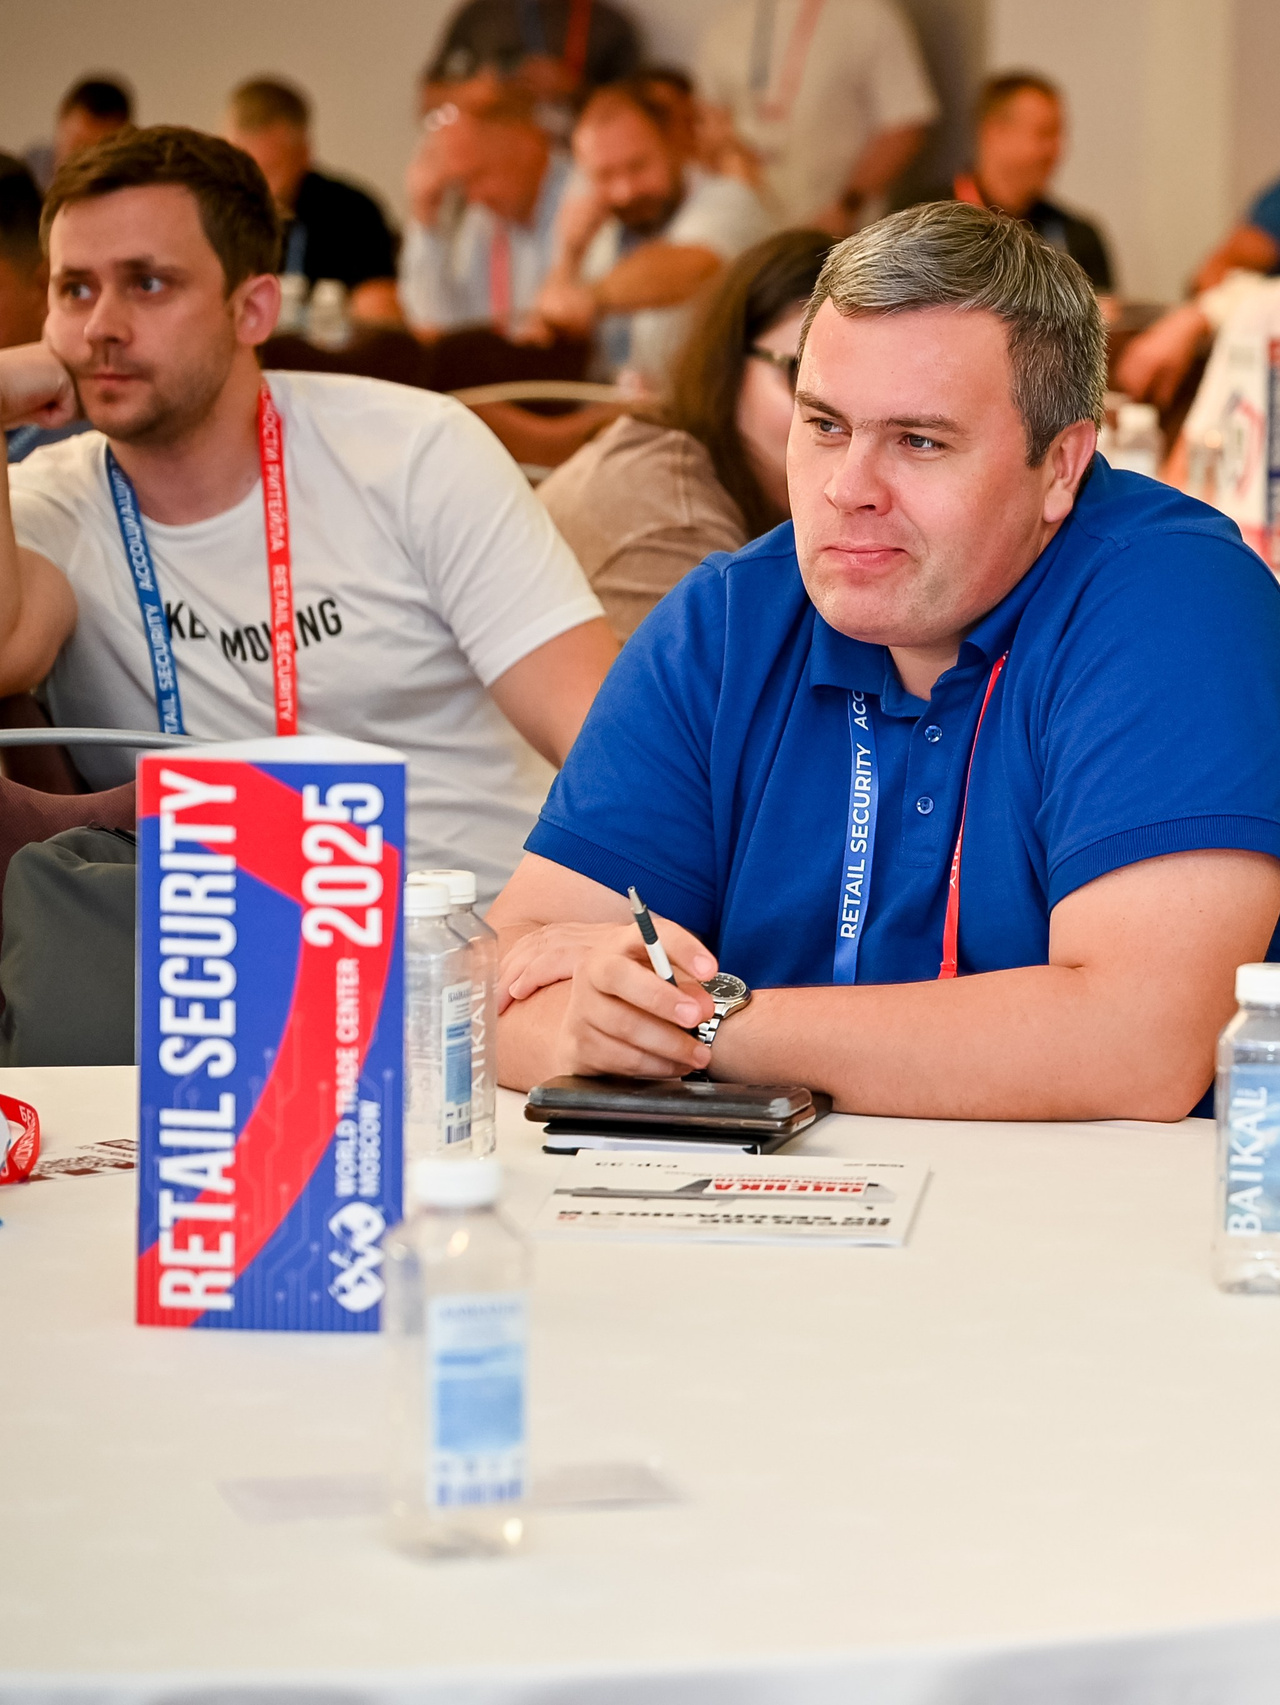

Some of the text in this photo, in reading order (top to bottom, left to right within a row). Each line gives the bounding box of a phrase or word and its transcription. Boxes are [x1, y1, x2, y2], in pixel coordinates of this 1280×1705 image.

[164, 693, 178, 735] TAIL
[302, 782, 384, 947] 2025
[840, 743, 872, 939] RETAIL SECURITY
[159, 769, 237, 1312] RETAIL SECURITY
[335, 957, 360, 1197] WORLD TRADE CENTER
[358, 1100, 381, 1197] MOSCOW
[1226, 1085, 1268, 1237] BAIKAL
